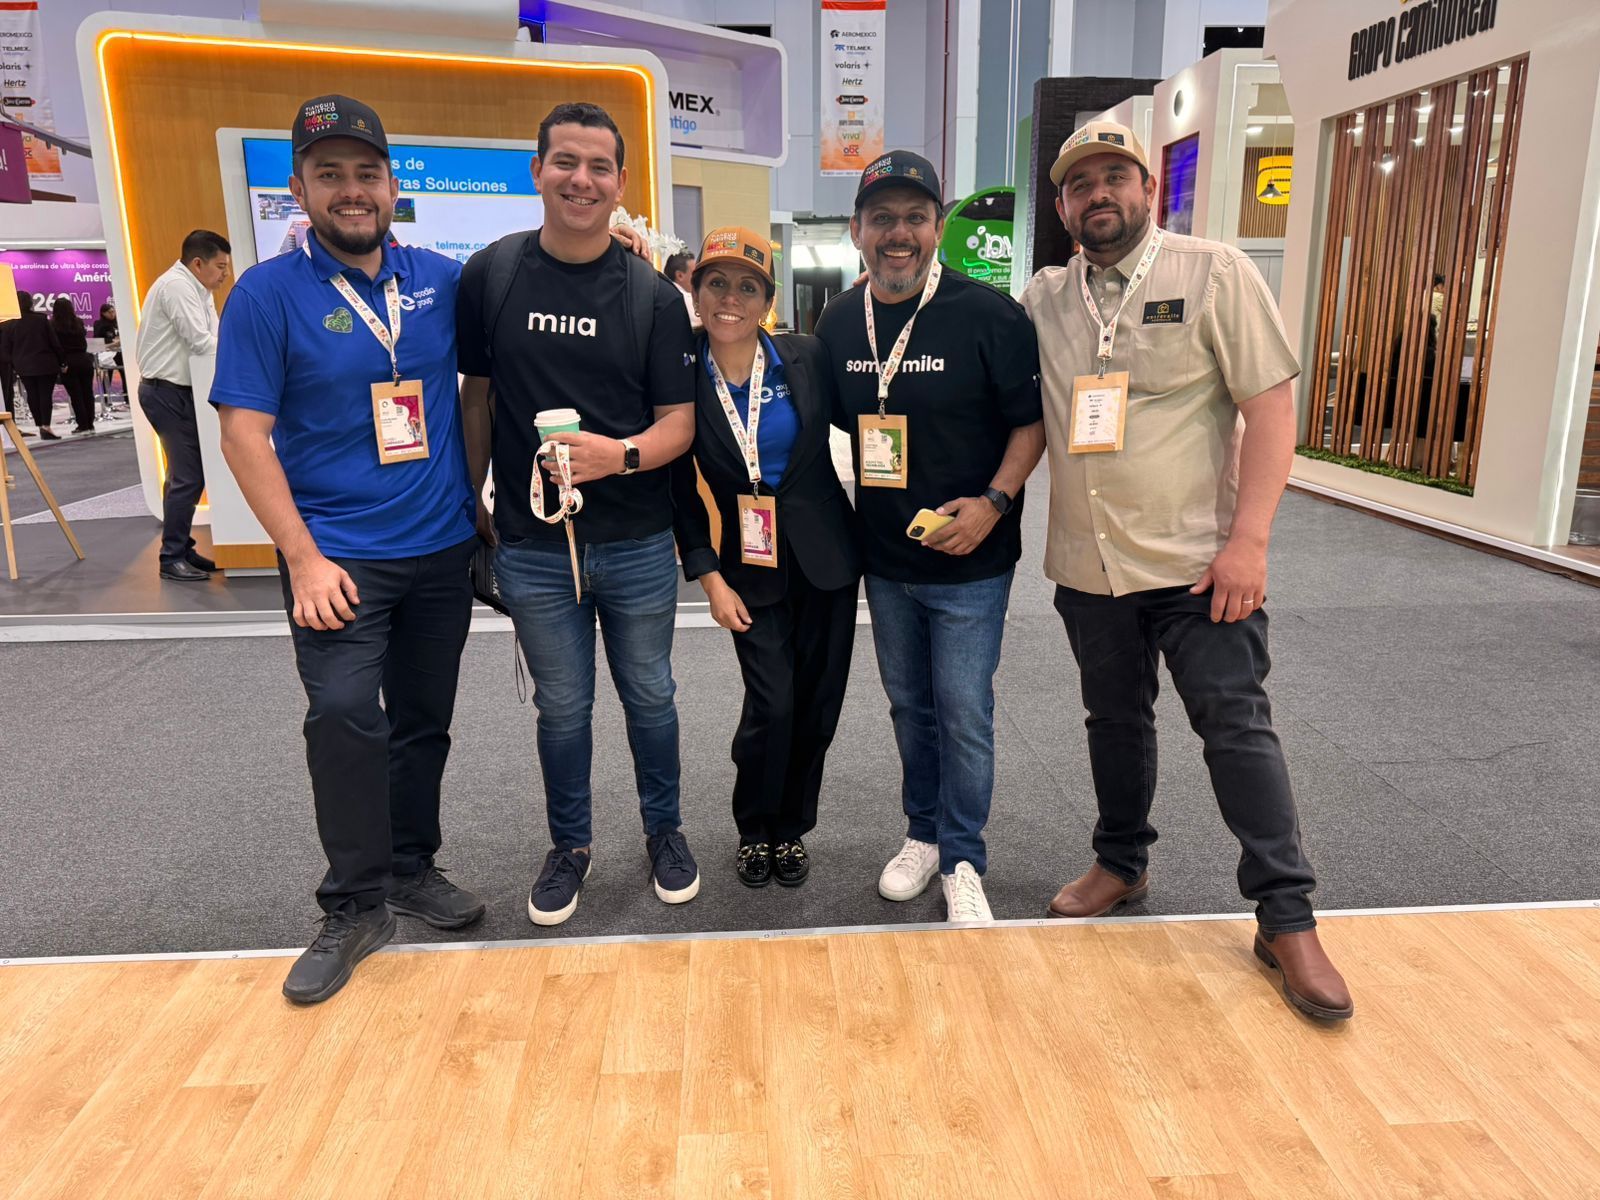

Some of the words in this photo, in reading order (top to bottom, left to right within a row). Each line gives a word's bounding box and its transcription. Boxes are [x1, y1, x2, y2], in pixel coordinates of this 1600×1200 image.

[1348, 17, 1396, 81] GRUPO
[835, 61, 861, 69] volaris
[4, 79, 27, 87] Hertz
[842, 77, 863, 85] Hertz
[405, 157, 425, 170] de
[425, 177, 508, 193] Soluciones
[76, 263, 91, 271] bajo
[528, 312, 597, 337] mila
[902, 354, 945, 373] mila
